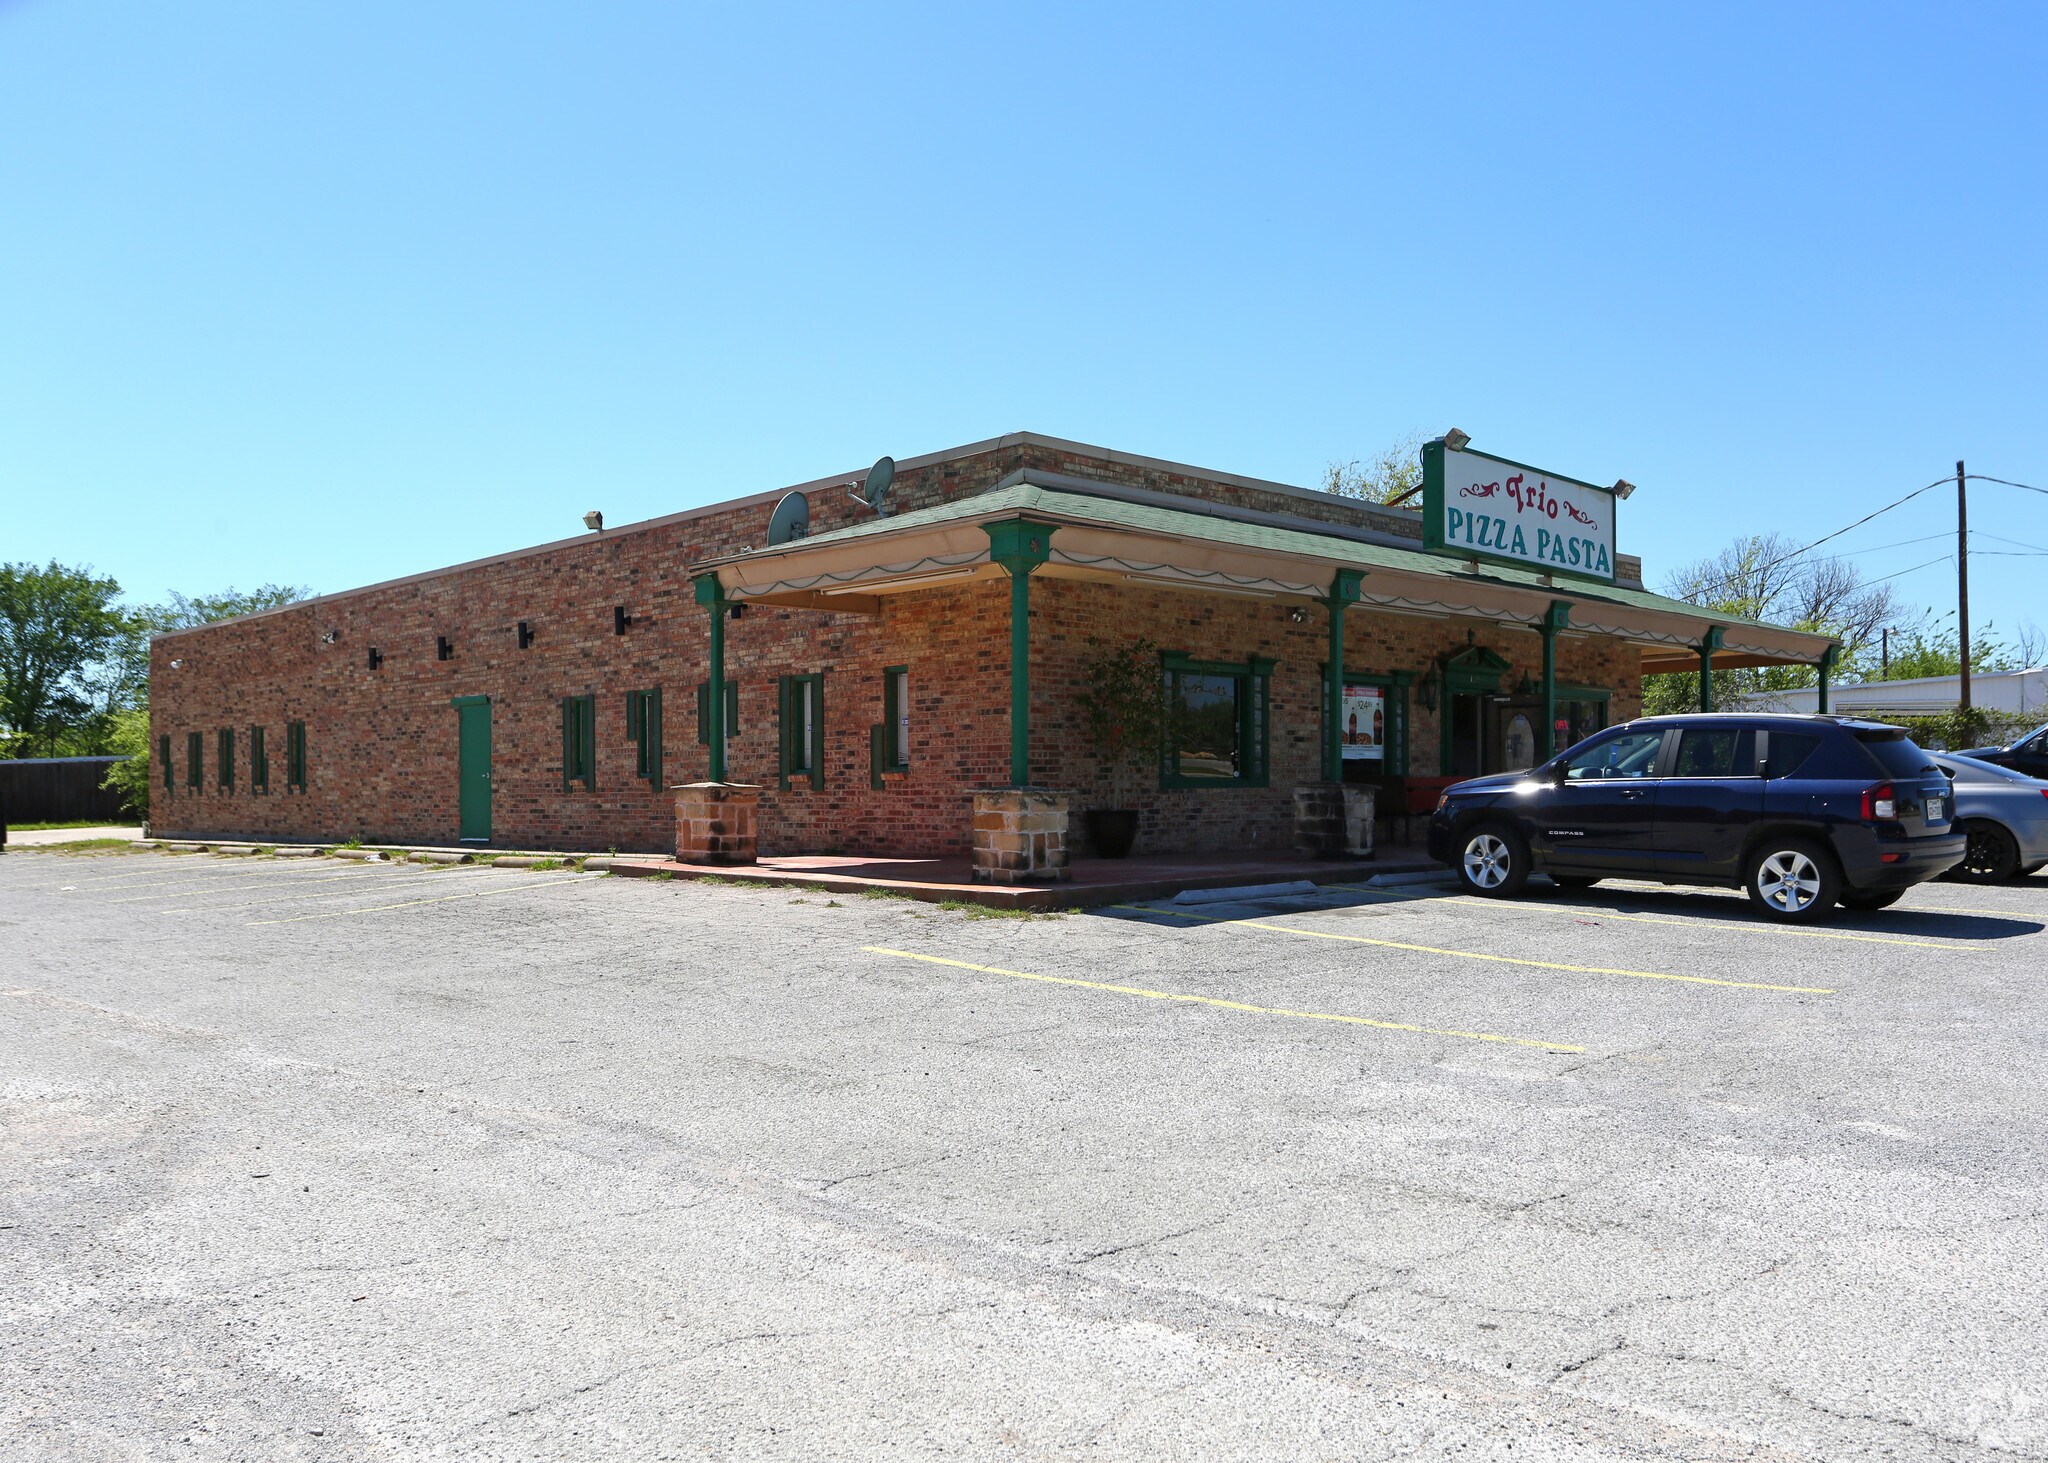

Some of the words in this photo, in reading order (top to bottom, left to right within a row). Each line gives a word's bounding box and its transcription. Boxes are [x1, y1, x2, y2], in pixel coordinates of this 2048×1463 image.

[1506, 473, 1558, 519] Trio
[1447, 507, 1528, 555] PIZZA
[1537, 528, 1610, 573] PASTA
[1555, 719, 1569, 730] OPEN
